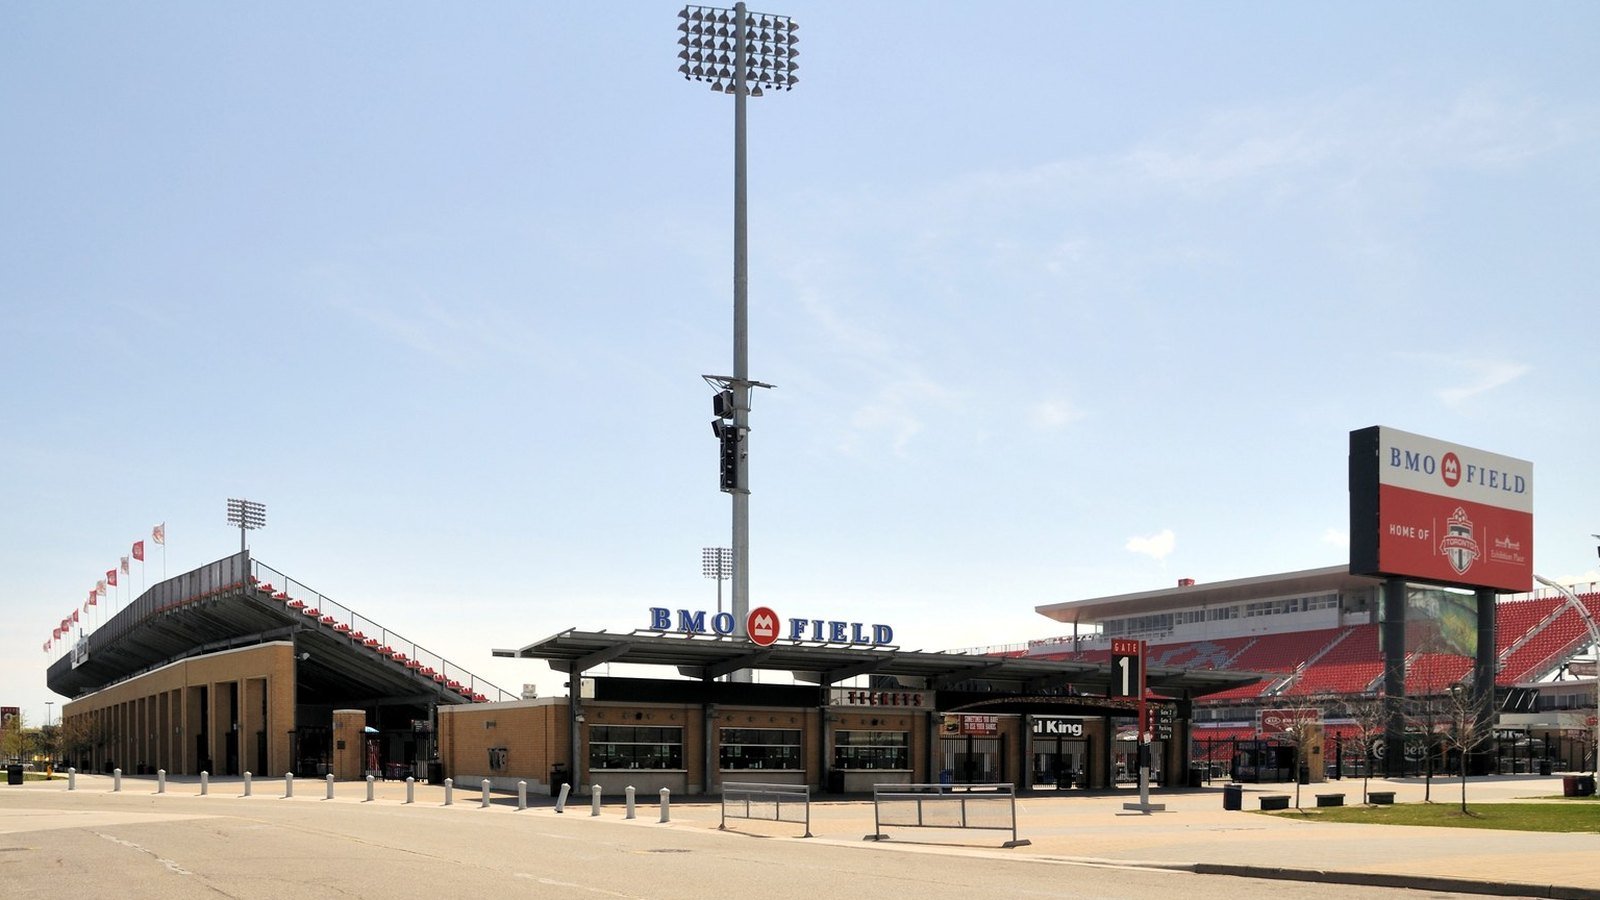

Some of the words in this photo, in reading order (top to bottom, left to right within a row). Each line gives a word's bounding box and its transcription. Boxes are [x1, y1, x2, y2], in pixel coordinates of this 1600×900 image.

[1390, 447, 1436, 475] BMO
[1466, 465, 1525, 493] FIELD
[1389, 523, 1415, 539] HOME
[1418, 528, 1430, 540] OF
[1445, 538, 1476, 550] TORONTO
[649, 607, 736, 635] BMO
[788, 617, 894, 645] FIELD
[1114, 643, 1137, 653] GATE
[1118, 656, 1130, 696] 1
[847, 690, 923, 706] TICKETS
[1046, 719, 1083, 737] King
